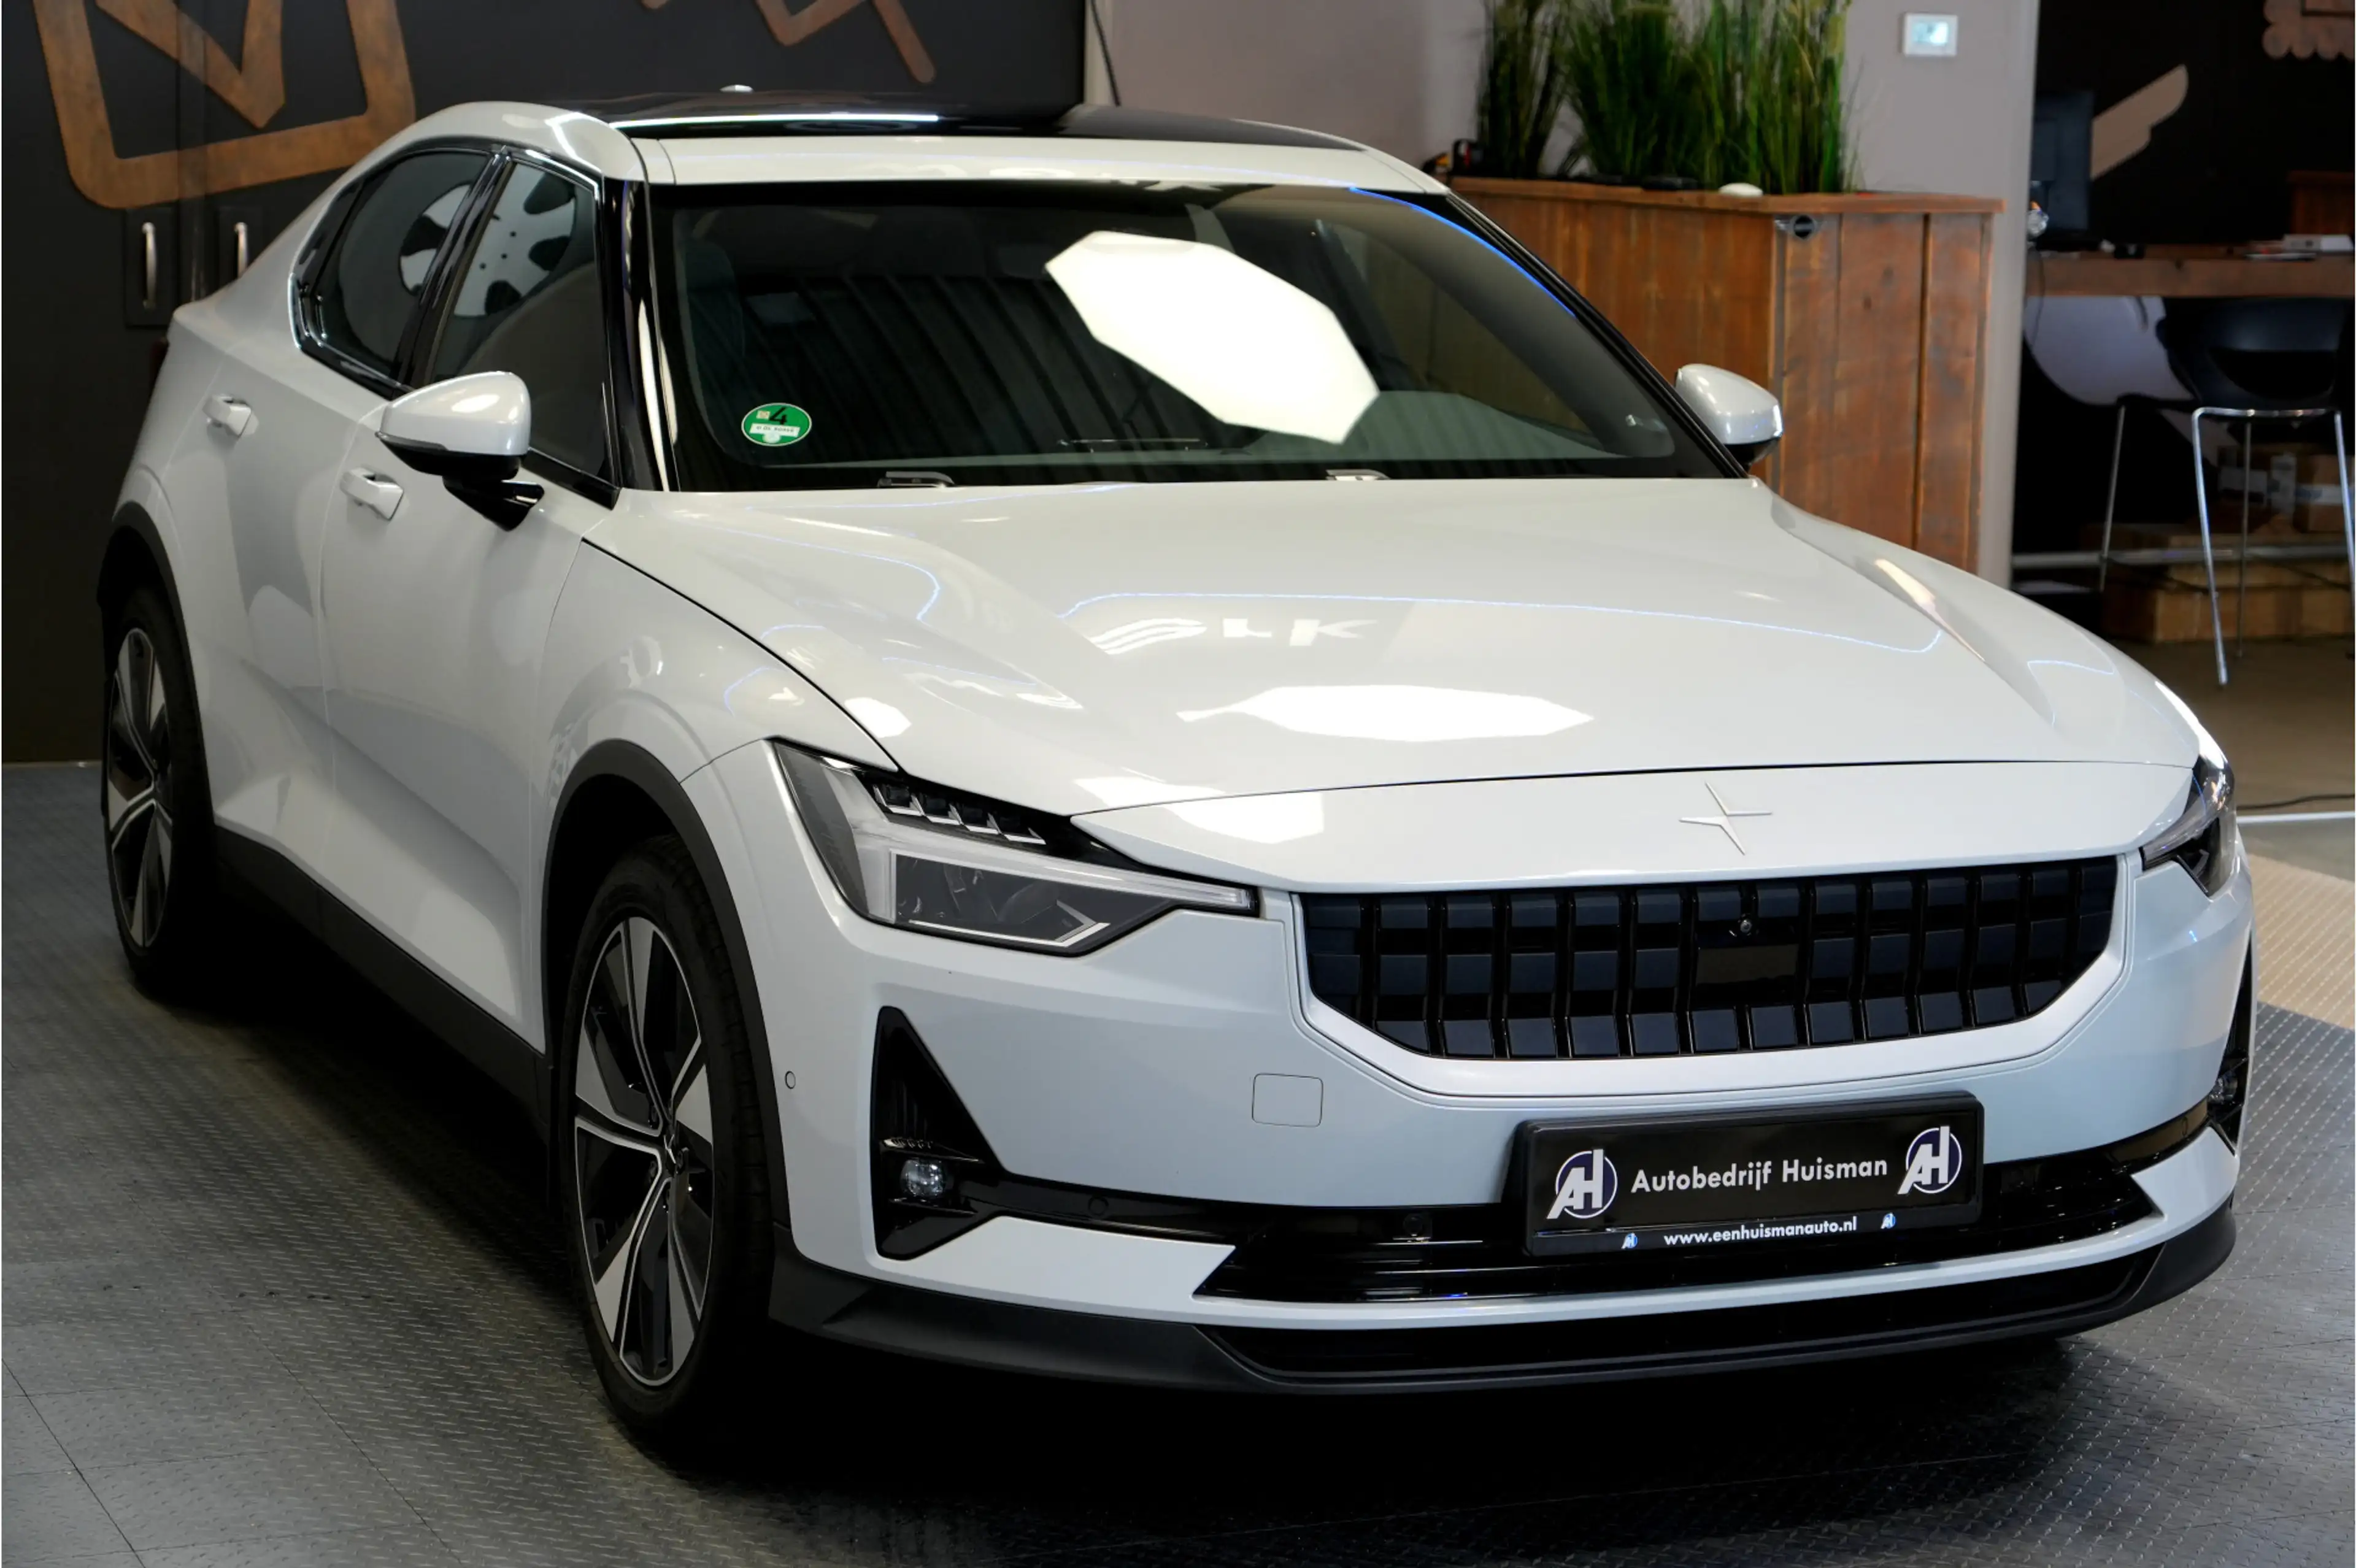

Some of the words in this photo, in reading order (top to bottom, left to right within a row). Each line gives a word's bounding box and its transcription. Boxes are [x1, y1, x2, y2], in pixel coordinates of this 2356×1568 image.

[769, 407, 788, 425] 4
[1546, 1148, 1604, 1220] AH
[1631, 1161, 1772, 1193] Autobedrijf
[1782, 1157, 1887, 1182] Huisman
[1897, 1126, 1950, 1194] AH
[1664, 1216, 1857, 1245] www.eenhuismanauto.nl
